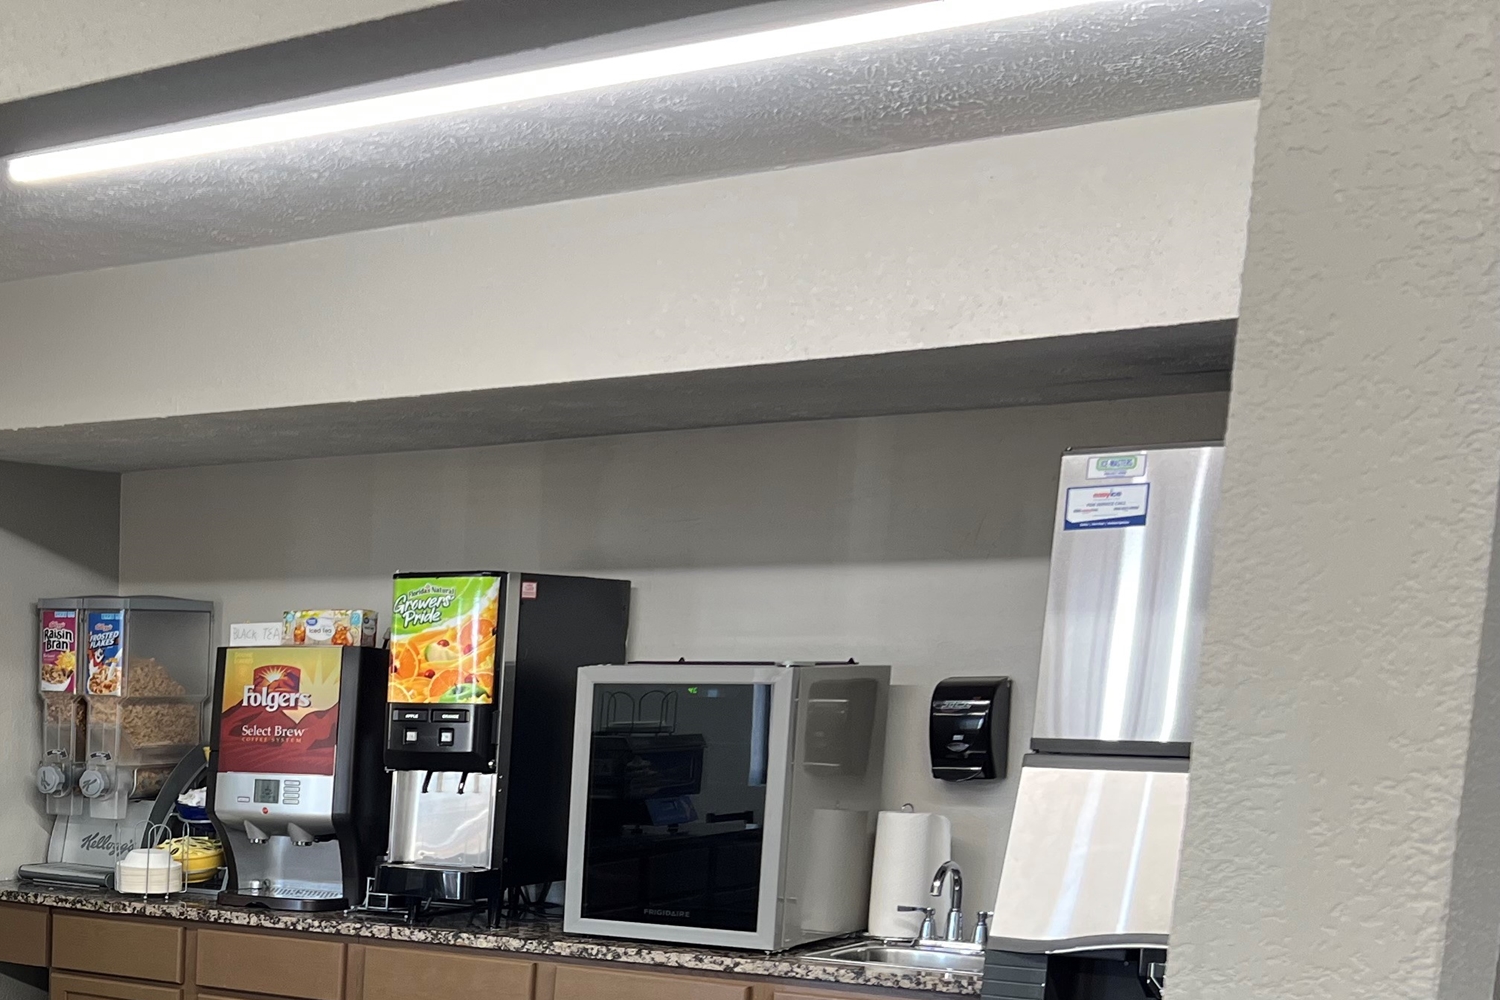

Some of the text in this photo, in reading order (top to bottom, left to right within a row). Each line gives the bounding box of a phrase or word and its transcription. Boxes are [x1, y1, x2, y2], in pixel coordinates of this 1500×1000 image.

[402, 607, 442, 628] Pride
[43, 628, 73, 641] Raisin
[90, 631, 120, 641] FROSTED
[263, 626, 280, 641] TEA
[322, 627, 332, 635] Tea
[45, 639, 69, 651] Bran
[90, 639, 115, 649] FLAKES
[241, 684, 312, 712] Folgers
[241, 724, 305, 737] Select Brew
[643, 908, 690, 918] FRIGIDAIRE
